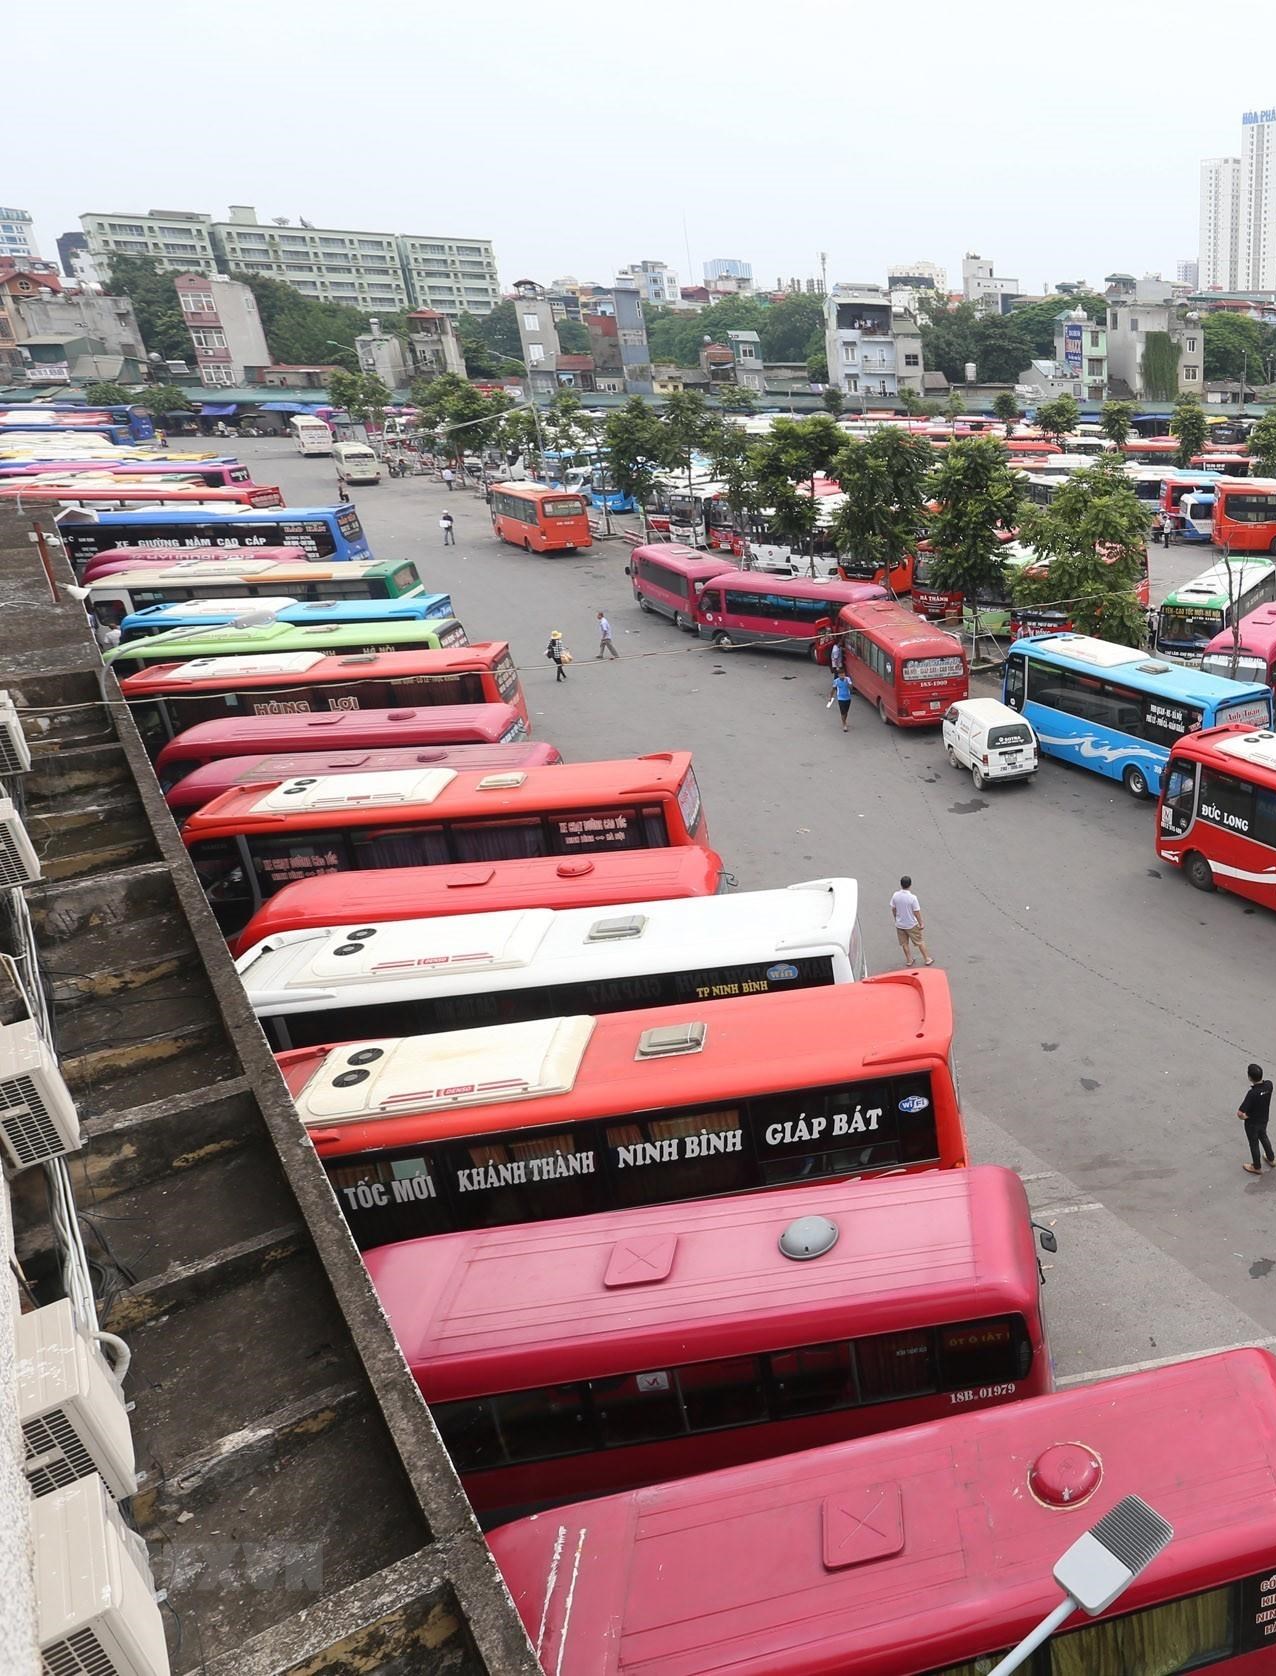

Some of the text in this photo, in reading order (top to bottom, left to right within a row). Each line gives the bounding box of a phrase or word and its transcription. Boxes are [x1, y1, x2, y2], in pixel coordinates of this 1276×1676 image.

[1201, 802, 1249, 832] ĐỨC LONG
[696, 979, 769, 999] TP NINH BÌNH
[444, 1084, 472, 1096] DENSO
[343, 1106, 883, 1211] TỐC MỚI KHÁNH THÀNH NINH BÌNH GIÁP BÁT
